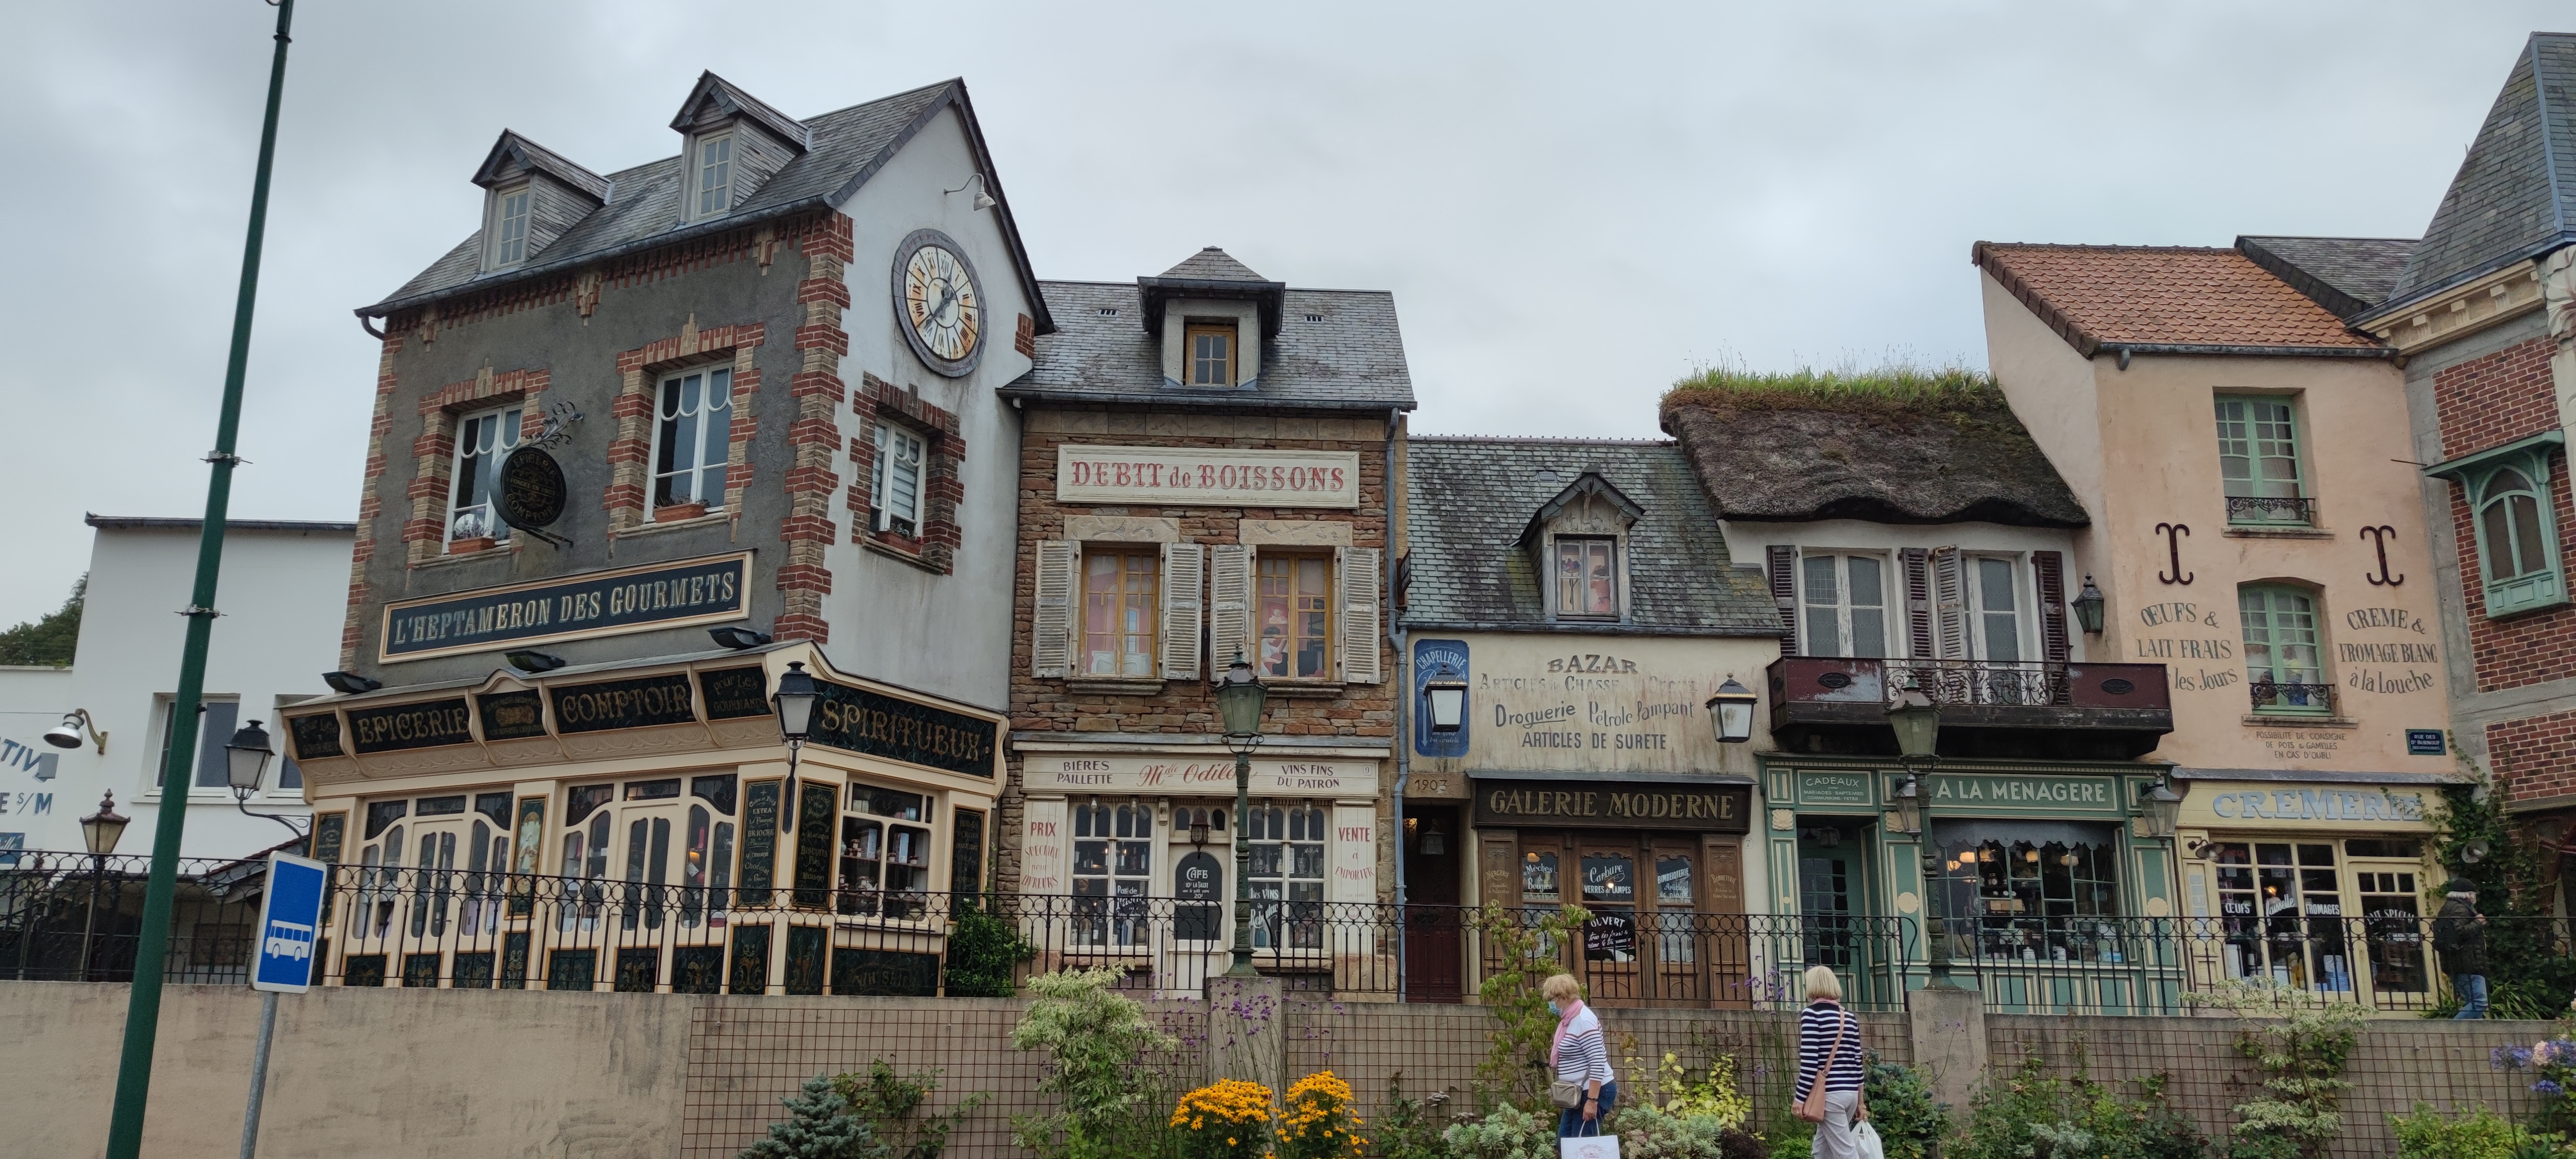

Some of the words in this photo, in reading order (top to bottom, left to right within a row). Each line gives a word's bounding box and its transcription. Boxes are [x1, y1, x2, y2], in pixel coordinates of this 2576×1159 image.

[513, 454, 556, 478] EPICERIE
[1071, 461, 1163, 487] DEBIT
[1169, 466, 1191, 487] de
[1197, 465, 1345, 491] BOISSONS
[507, 494, 555, 520] COMPTOIR
[394, 597, 552, 644] L'HEPTAMERON
[560, 591, 601, 623] DES
[609, 571, 735, 615] GOURMETS
[2141, 602, 2196, 627] ŒUFS
[2204, 611, 2220, 628] &
[2347, 608, 2408, 630] CREME
[2411, 618, 2426, 634] &
[2136, 639, 2174, 658] LAIT
[2179, 639, 2232, 659] FRAIS
[2338, 643, 2399, 663] FROMAGE
[2399, 643, 2437, 663] BLANC
[1416, 650, 1467, 670] CHAPELLERIE
[1547, 654, 1639, 674] BAZAR
[2174, 667, 2195, 691] les
[2199, 668, 2238, 691] Jours
[2349, 666, 2358, 688] à
[2360, 668, 2375, 692] la
[2377, 670, 2434, 694] Louche
[562, 684, 689, 723] COMPTOIR
[1496, 700, 1576, 728] Droguerie
[1588, 701, 1632, 727] Pétrole
[358, 708, 468, 744] EPICERIE
[821, 699, 980, 761] SPIRITUEUX
[2256, 731, 2292, 739] POSSIBILITE
[1521, 732, 1581, 748] ARTICLES
[1592, 732, 1607, 749] DE
[1616, 733, 1667, 749] SURETE
[2304, 751, 2331, 759] D'OUBLI
[1057, 773, 1113, 784] PAILLETTE
[1183, 763, 1258, 783] Odilo
[1281, 764, 1306, 774] VINS
[1311, 765, 1333, 776] FINS
[1277, 777, 1292, 787] DU
[1298, 778, 1340, 788] PATRON
[1806, 777, 1859, 787] CADEAUX
[1936, 778, 1952, 798] A
[1958, 779, 1983, 799] LA
[1991, 781, 2105, 801] MENAGERE
[1490, 788, 1597, 817] GALERIE
[1607, 792, 1733, 820] MODERNE
[2212, 788, 2423, 821] CREMERIE
[1031, 822, 1056, 837] PRIX
[1339, 827, 1370, 842] VENTE
[1352, 849, 1358, 859] à
[745, 862, 769, 875] Chocolat
[1335, 866, 1375, 880] EMPORTER
[1486, 870, 1510, 881] MERCERIE
[1525, 863, 1553, 874] Mèches
[1590, 865, 1623, 883] Carbure
[1117, 885, 1127, 894] Pas
[1129, 886, 1138, 894] de
[1250, 887, 1261, 899] Les
[1262, 889, 1279, 899] VINS
[1528, 878, 1553, 893] Bougies
[1584, 885, 1605, 893] VERRES
[1612, 886, 1631, 894] LAMPES
[2226, 903, 2250, 914] ŒUFS
[2305, 903, 2340, 915] FROMAGES
